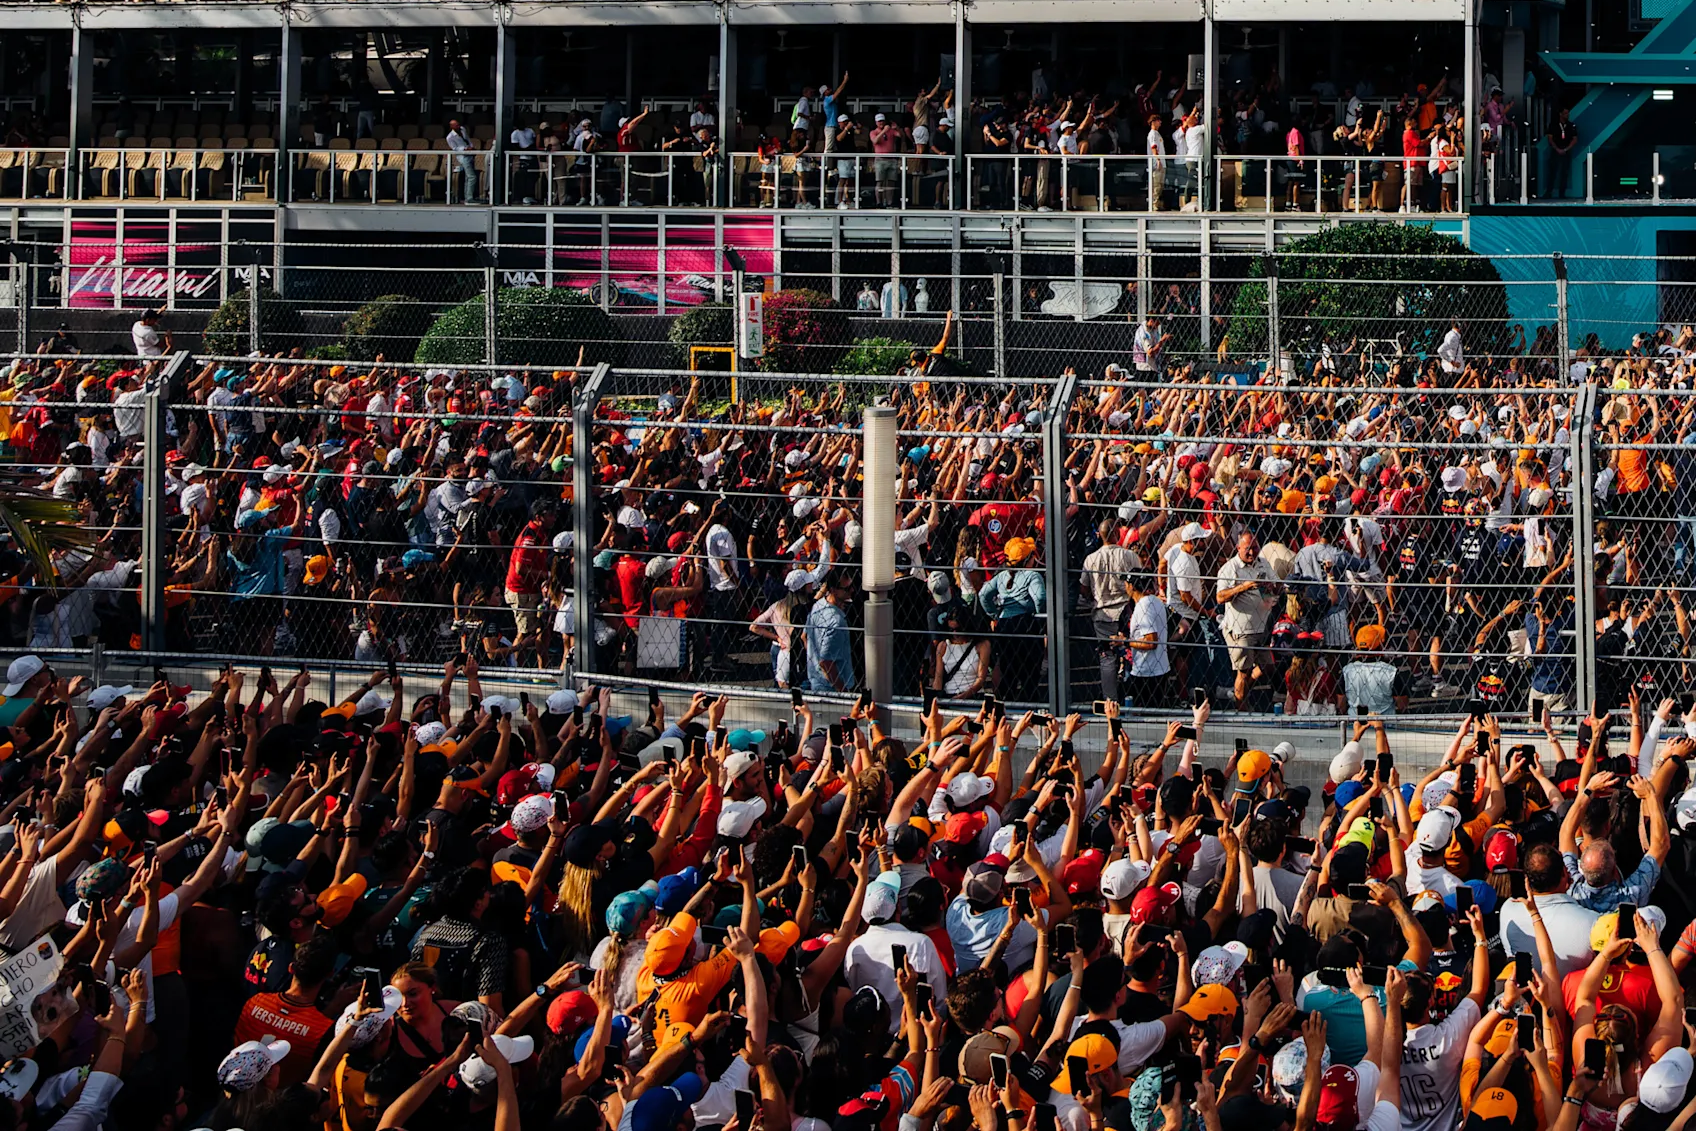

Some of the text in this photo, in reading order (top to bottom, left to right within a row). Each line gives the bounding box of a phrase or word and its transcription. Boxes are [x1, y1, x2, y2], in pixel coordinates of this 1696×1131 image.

[70, 255, 221, 298] Miami
[235, 267, 271, 279] MA
[503, 271, 541, 284] MIA
[0, 952, 38, 988] UIERO
[244, 966, 259, 985] Red
[250, 1005, 311, 1037] VERSTAPPEN
[1505, 1021, 1513, 1031] 4
[672, 1026, 680, 1037] 4
[1401, 1044, 1440, 1065] LERC
[1400, 1073, 1444, 1121] 16
